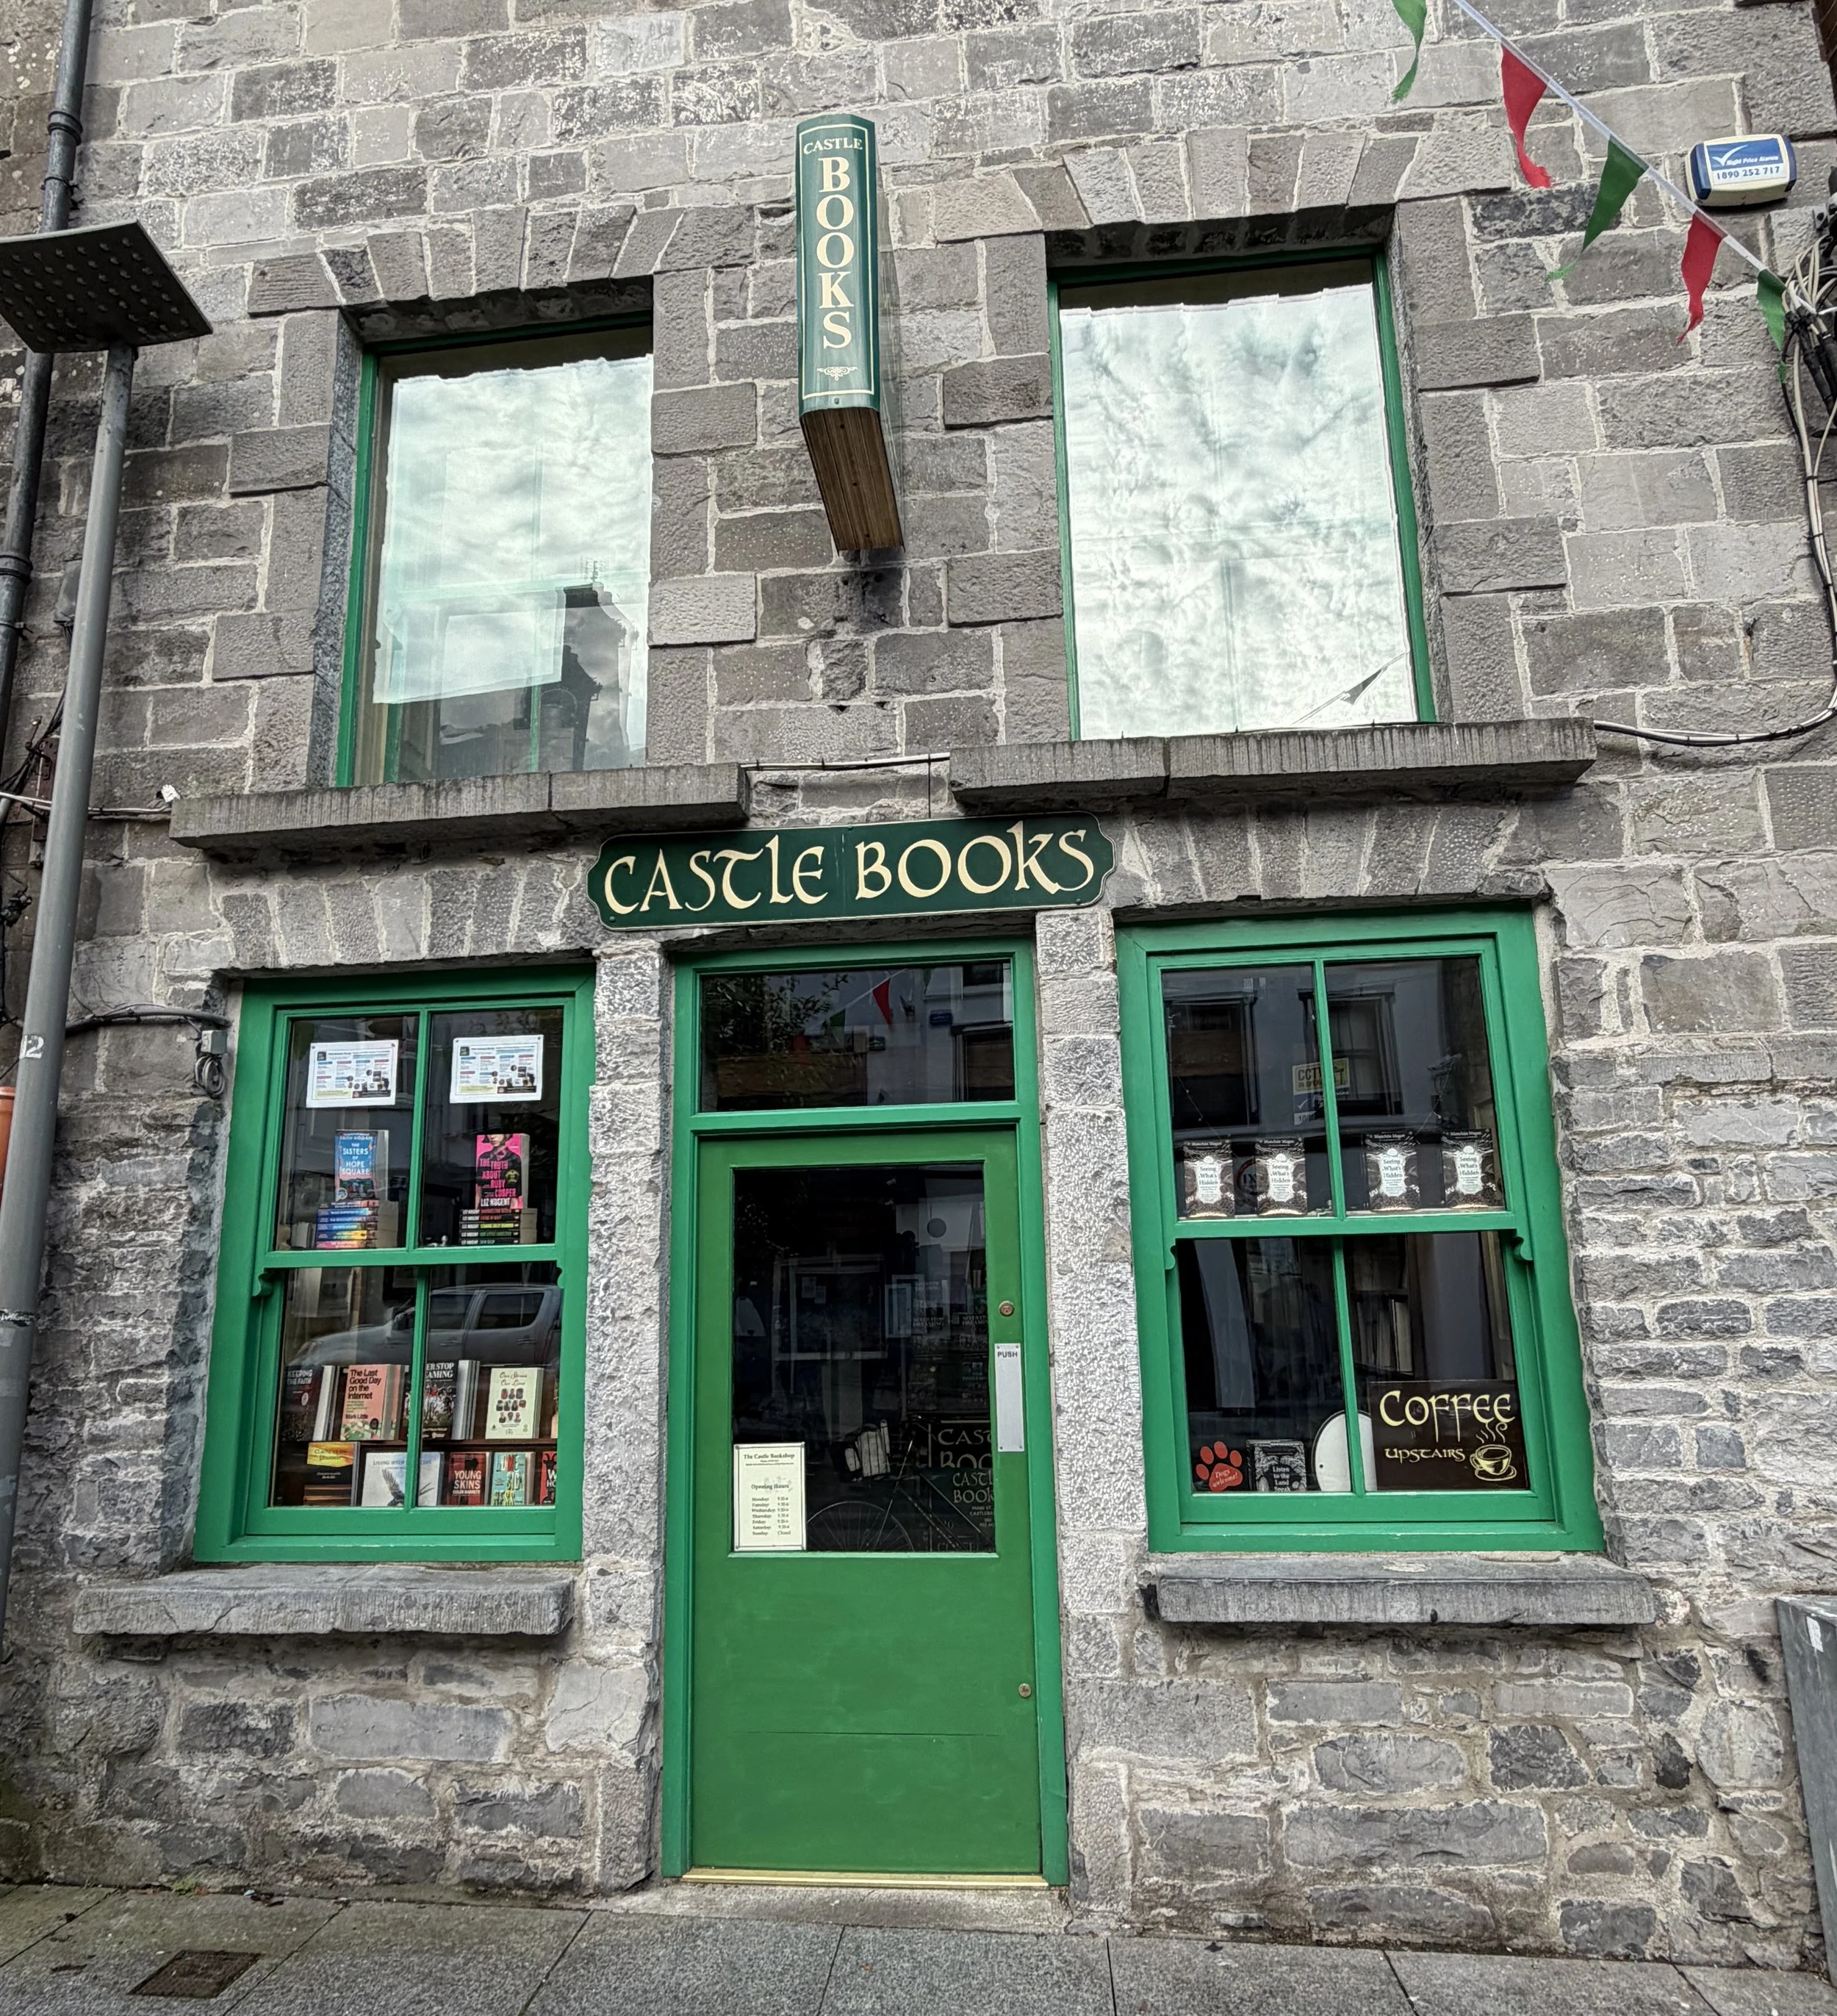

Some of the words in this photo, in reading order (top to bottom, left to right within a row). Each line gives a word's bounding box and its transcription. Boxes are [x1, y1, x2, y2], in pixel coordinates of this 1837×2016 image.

[803, 137, 863, 154] CASTLE
[1716, 170, 1739, 180] 1890
[1742, 168, 1761, 177] 252
[1763, 166, 1780, 175] 717
[816, 157, 855, 349] BOOKS
[604, 834, 828, 914] CASTLE
[855, 819, 1095, 901] BOOKS
[482, 1170, 500, 1179] ABOUT
[491, 1180, 506, 1188] RUBY
[481, 1199, 489, 1207] LIZ
[350, 1368, 363, 1377] The
[363, 1368, 378, 1377] Last
[349, 1377, 367, 1385] Good
[368, 1377, 381, 1386] Day
[359, 1384, 370, 1392] the
[1379, 1391, 1516, 1443] COFFEE
[453, 1470, 482, 1479] YOUNG
[1215, 1469, 1231, 1479] Dogs
[453, 1480, 481, 1490] SKINS
[1212, 1472, 1238, 1488] welcome!
